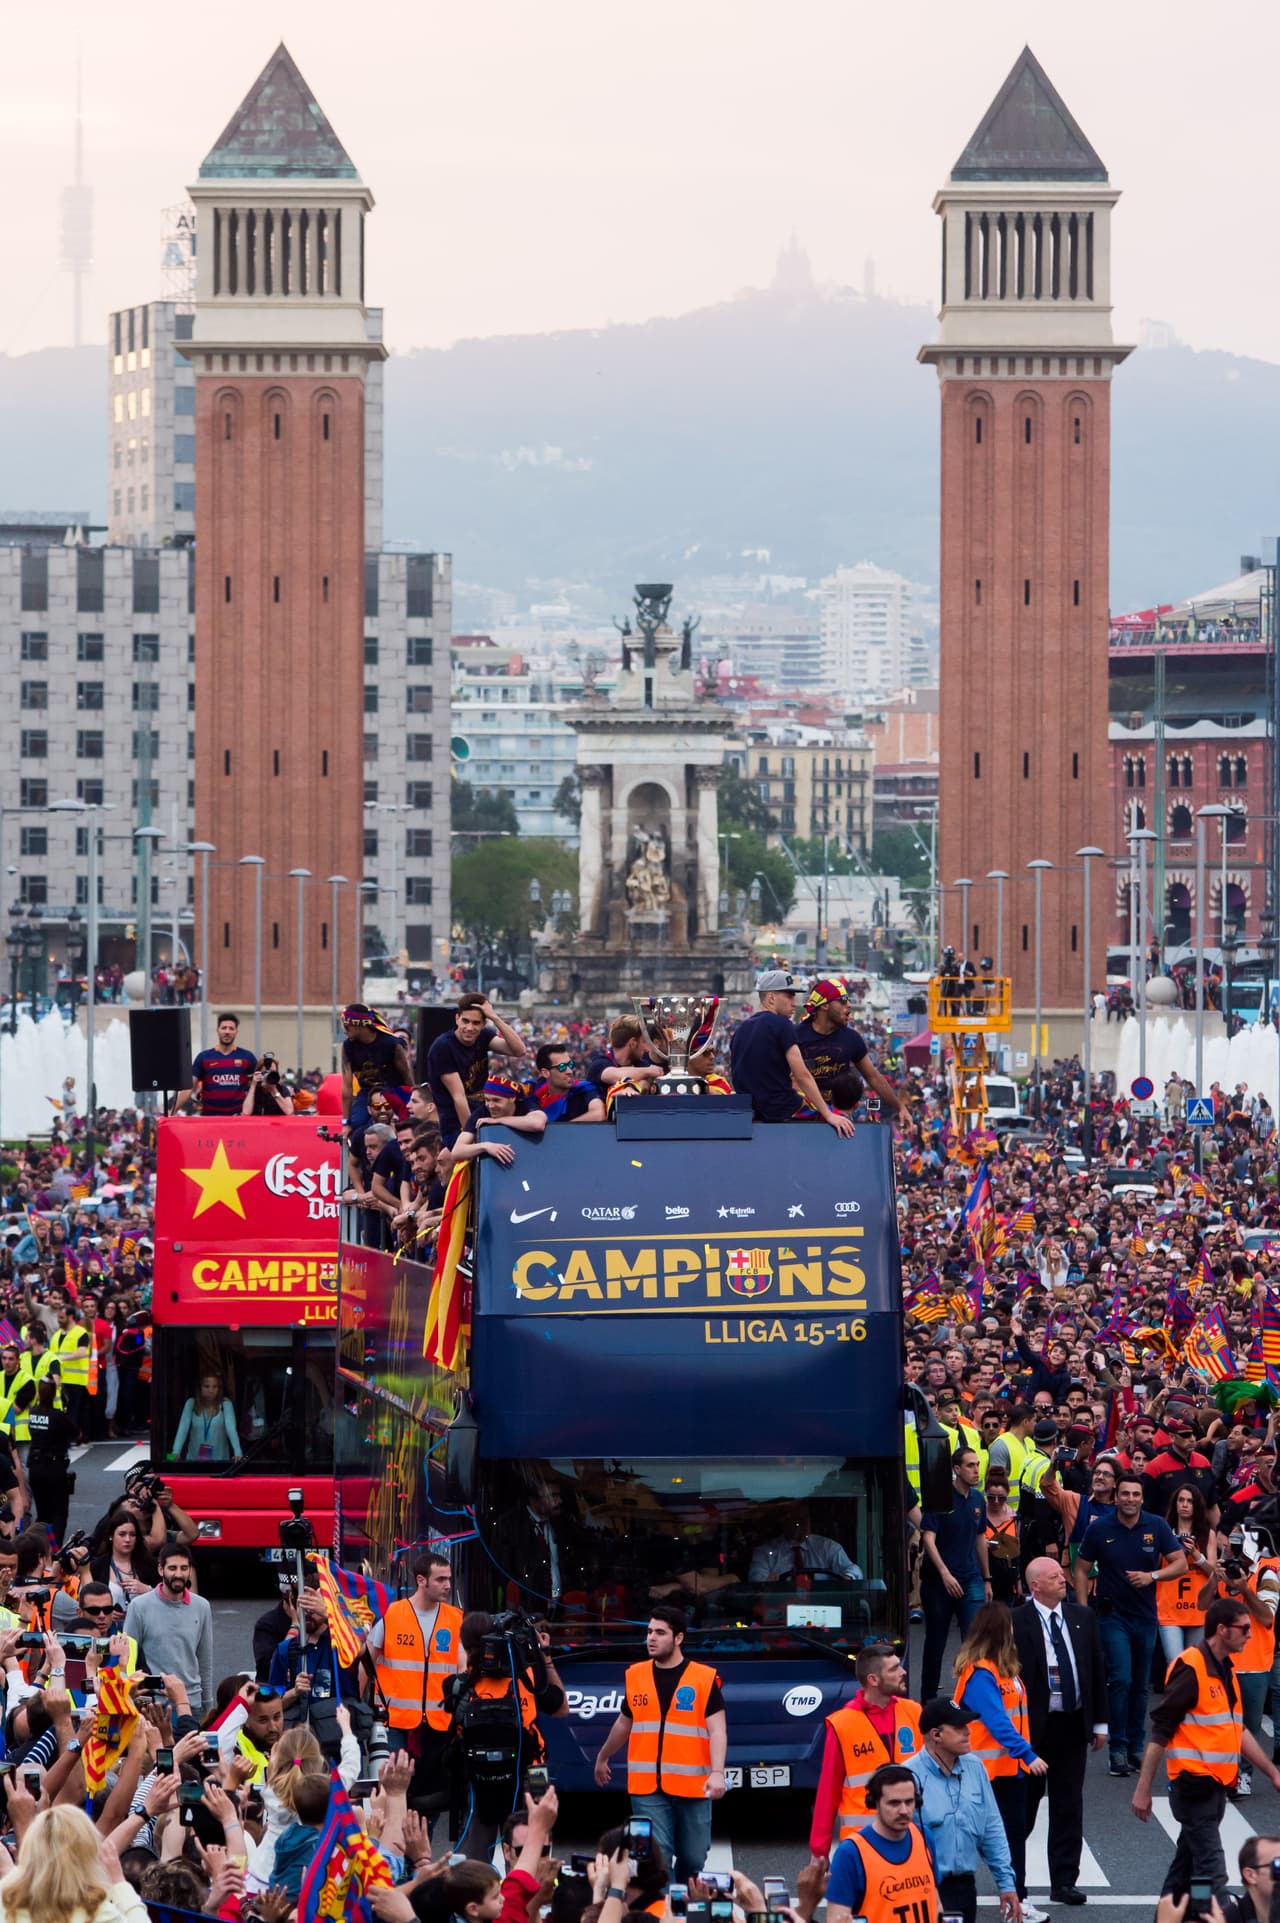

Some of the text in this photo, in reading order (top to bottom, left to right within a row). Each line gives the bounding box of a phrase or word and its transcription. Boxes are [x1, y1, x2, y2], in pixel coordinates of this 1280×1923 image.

[212, 1075, 240, 1083] QATAR
[307, 1197, 339, 1219] Da
[581, 1207, 620, 1218] QATAR
[665, 1206, 690, 1215] beko
[704, 1318, 867, 1346] LLIGA 15-16
[1178, 1578, 1191, 1600] F
[1176, 1602, 1196, 1610] 084
[396, 1634, 415, 1646] 522
[632, 1694, 649, 1707] 536
[791, 1696, 817, 1706] TMB
[853, 1740, 875, 1757] 644
